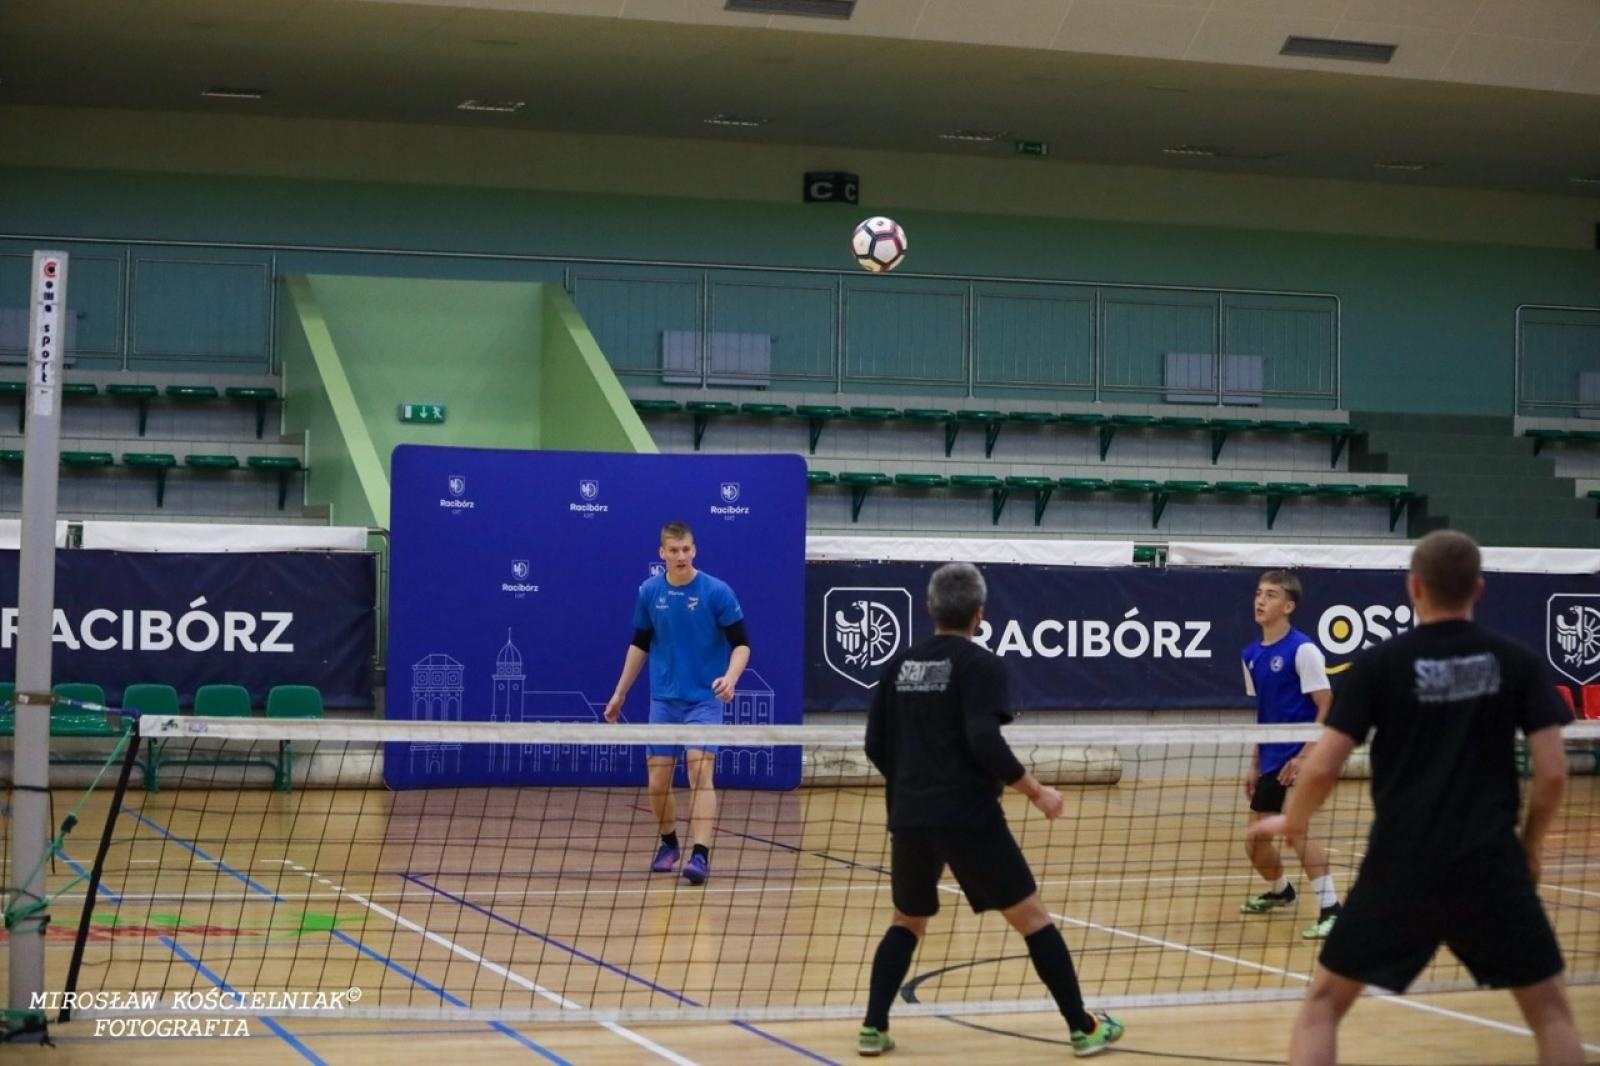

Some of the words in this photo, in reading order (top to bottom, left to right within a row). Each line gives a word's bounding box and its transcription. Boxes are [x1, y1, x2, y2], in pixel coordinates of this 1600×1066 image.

[810, 181, 833, 199] C
[41, 323, 52, 383] sport
[440, 499, 474, 508] Racibórz
[569, 503, 609, 512] Racibórz
[710, 505, 750, 514] Racibórz
[502, 583, 539, 592] Racibórz
